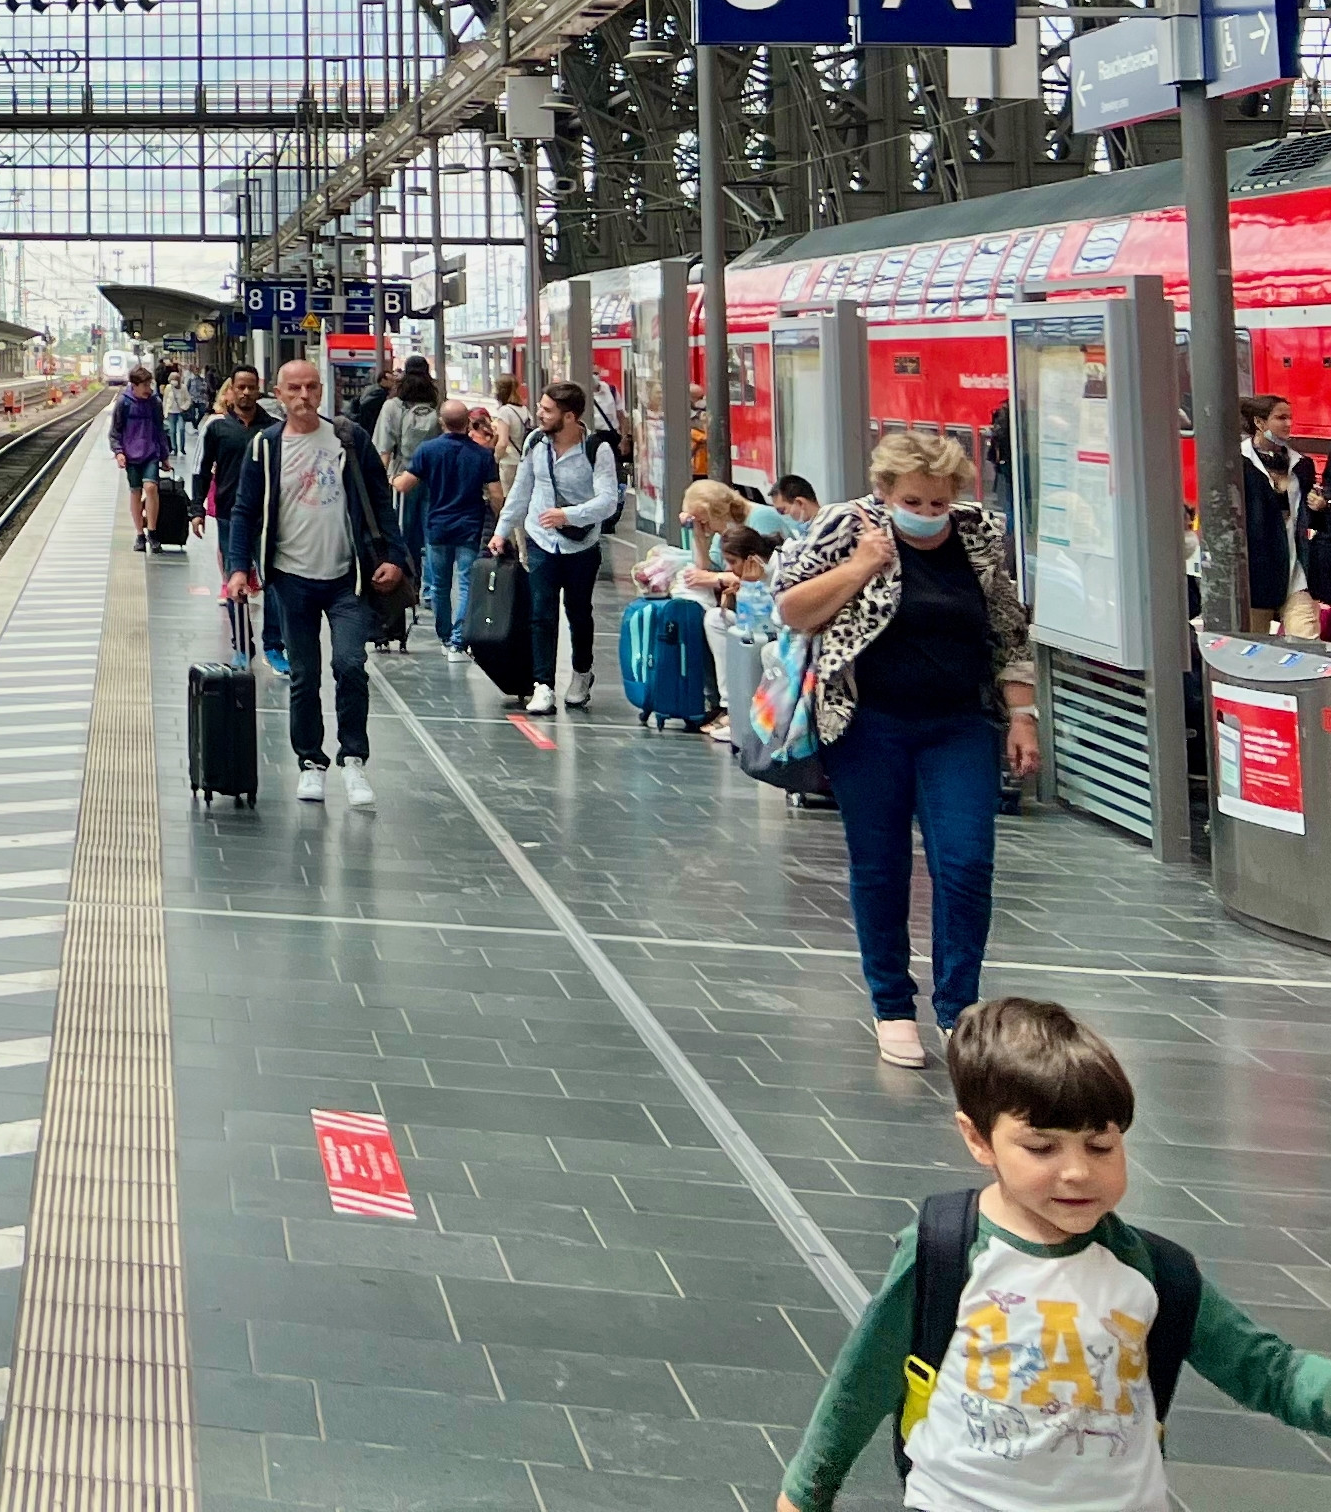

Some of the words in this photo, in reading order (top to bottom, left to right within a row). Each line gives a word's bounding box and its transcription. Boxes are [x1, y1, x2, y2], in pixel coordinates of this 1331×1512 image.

[248, 288, 264, 311] 8
[279, 290, 296, 312] B
[384, 292, 402, 314] B
